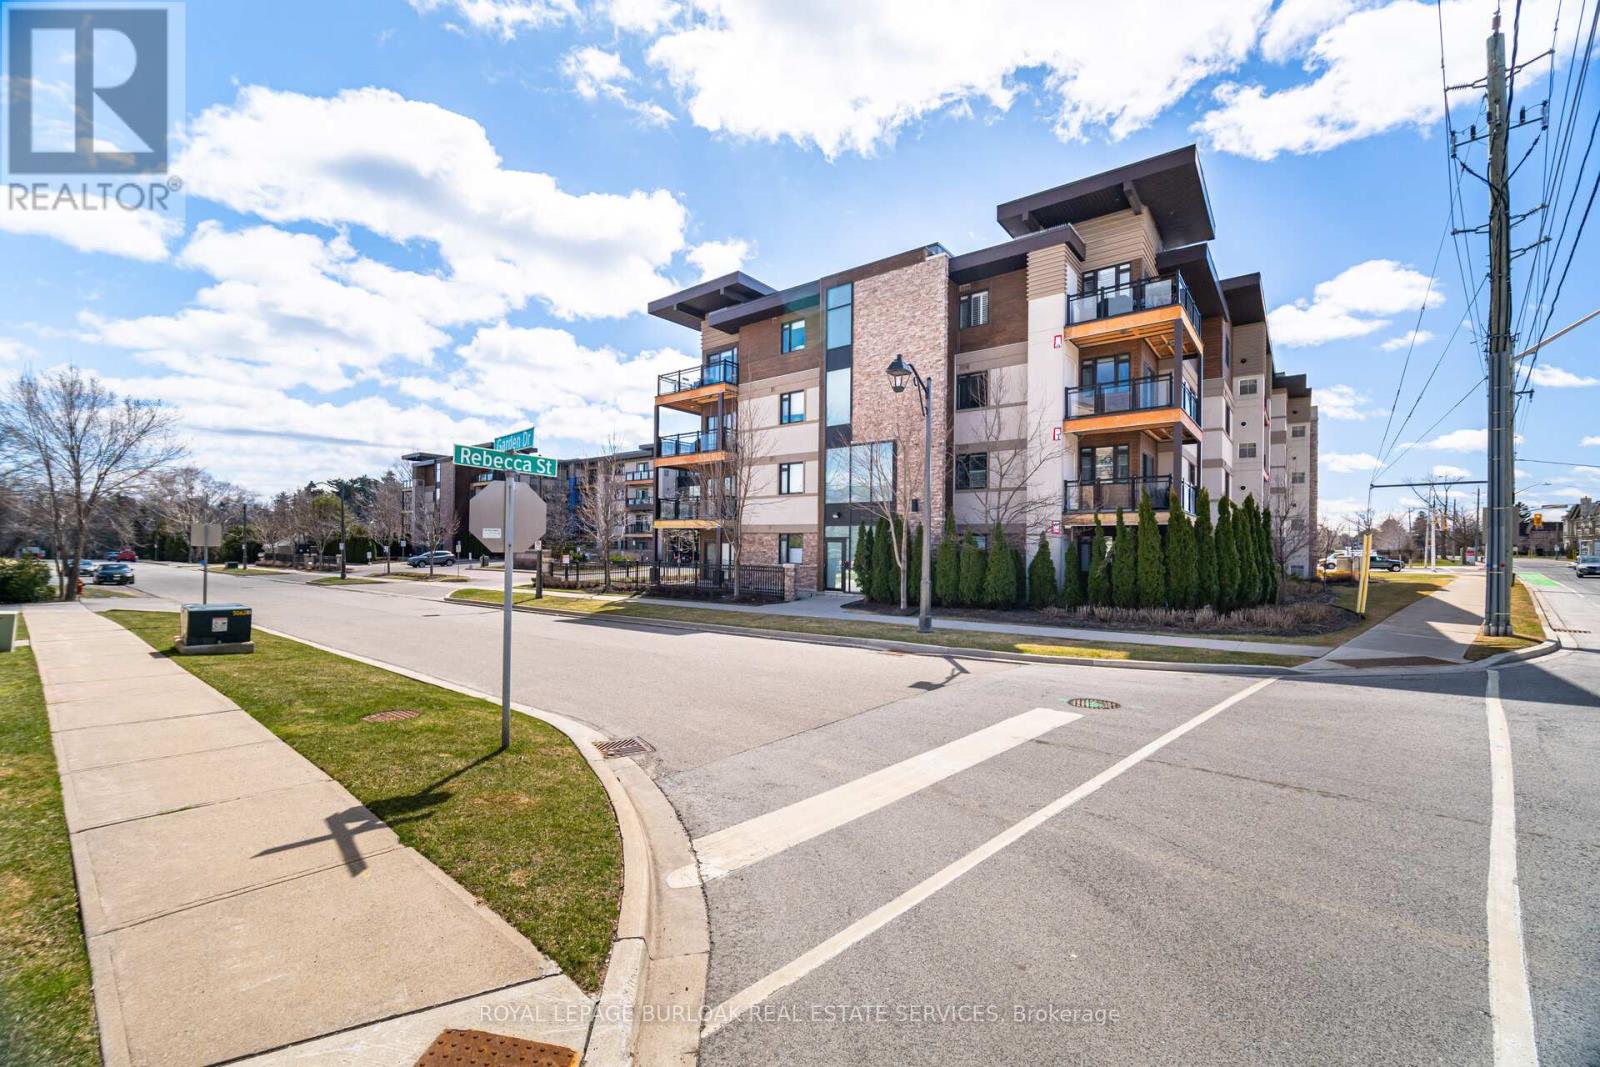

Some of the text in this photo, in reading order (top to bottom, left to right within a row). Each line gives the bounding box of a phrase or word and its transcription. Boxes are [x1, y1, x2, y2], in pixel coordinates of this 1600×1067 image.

[496, 431, 531, 450] Garden Dr
[460, 448, 552, 474] Rebecca St
